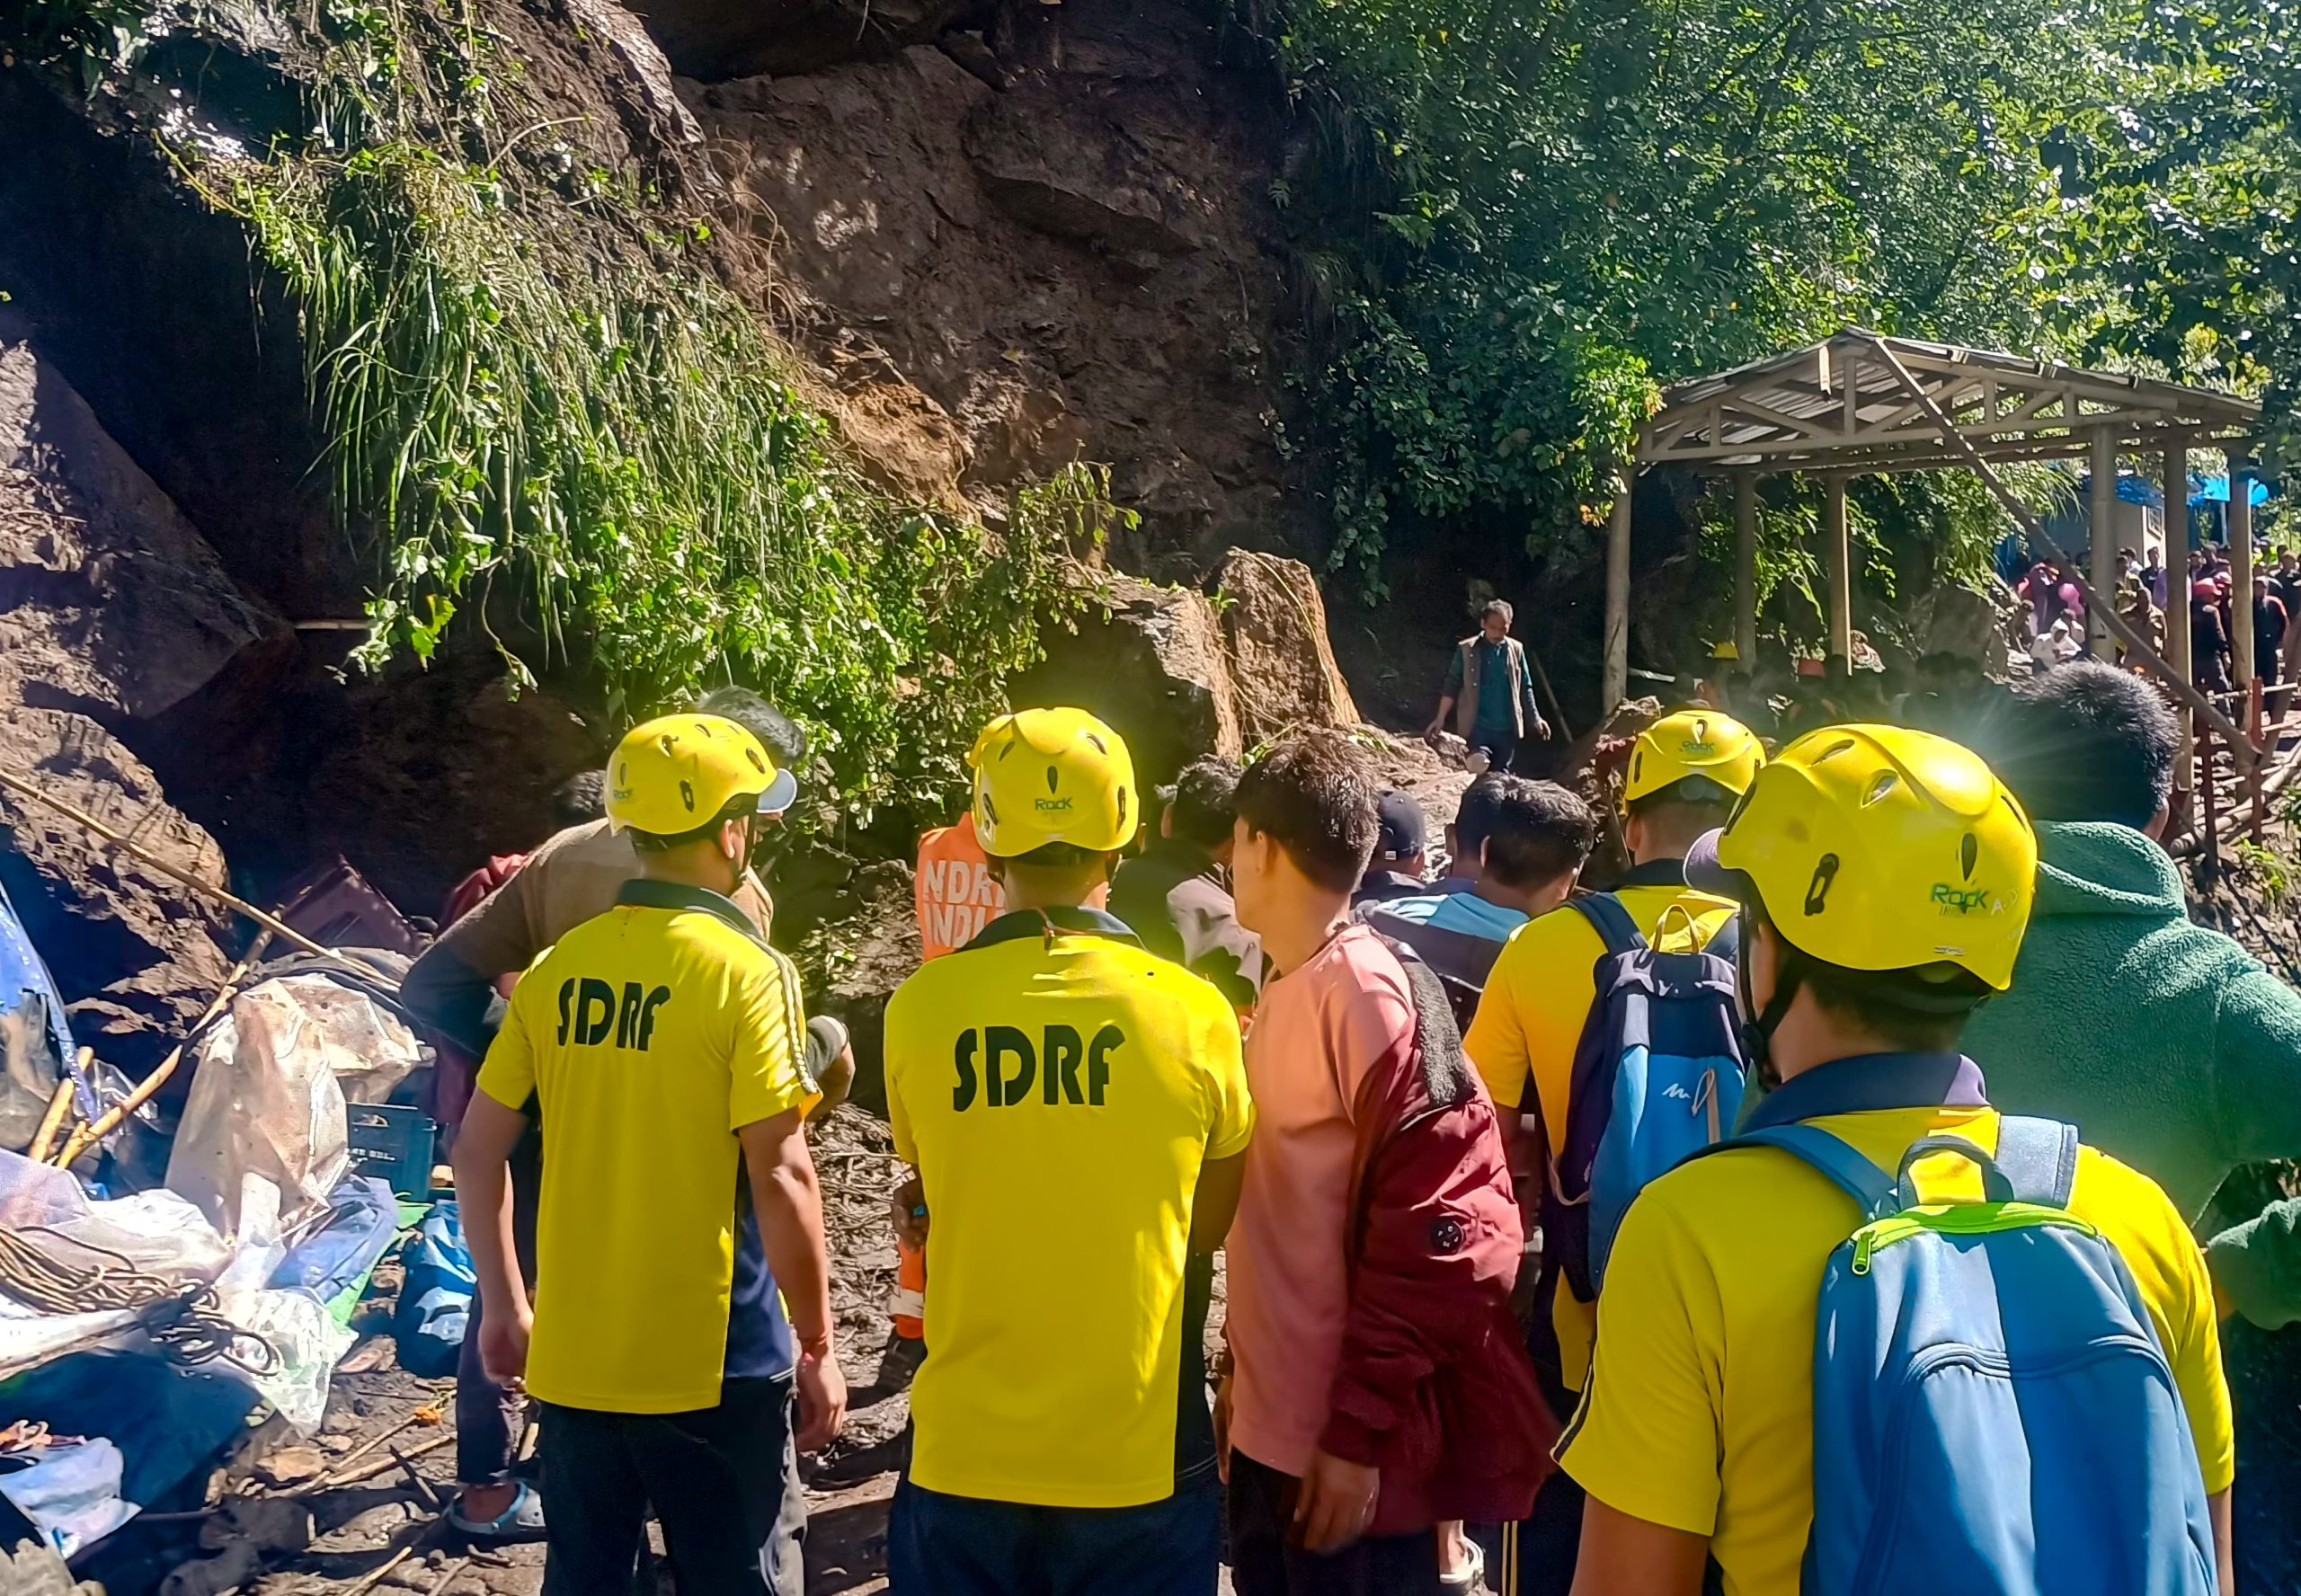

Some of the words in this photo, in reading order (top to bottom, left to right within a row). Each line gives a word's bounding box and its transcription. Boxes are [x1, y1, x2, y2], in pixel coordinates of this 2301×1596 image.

[923, 903, 1005, 948] INDI
[557, 978, 671, 1051] SDRF
[953, 1024, 1125, 1112] SDRF
